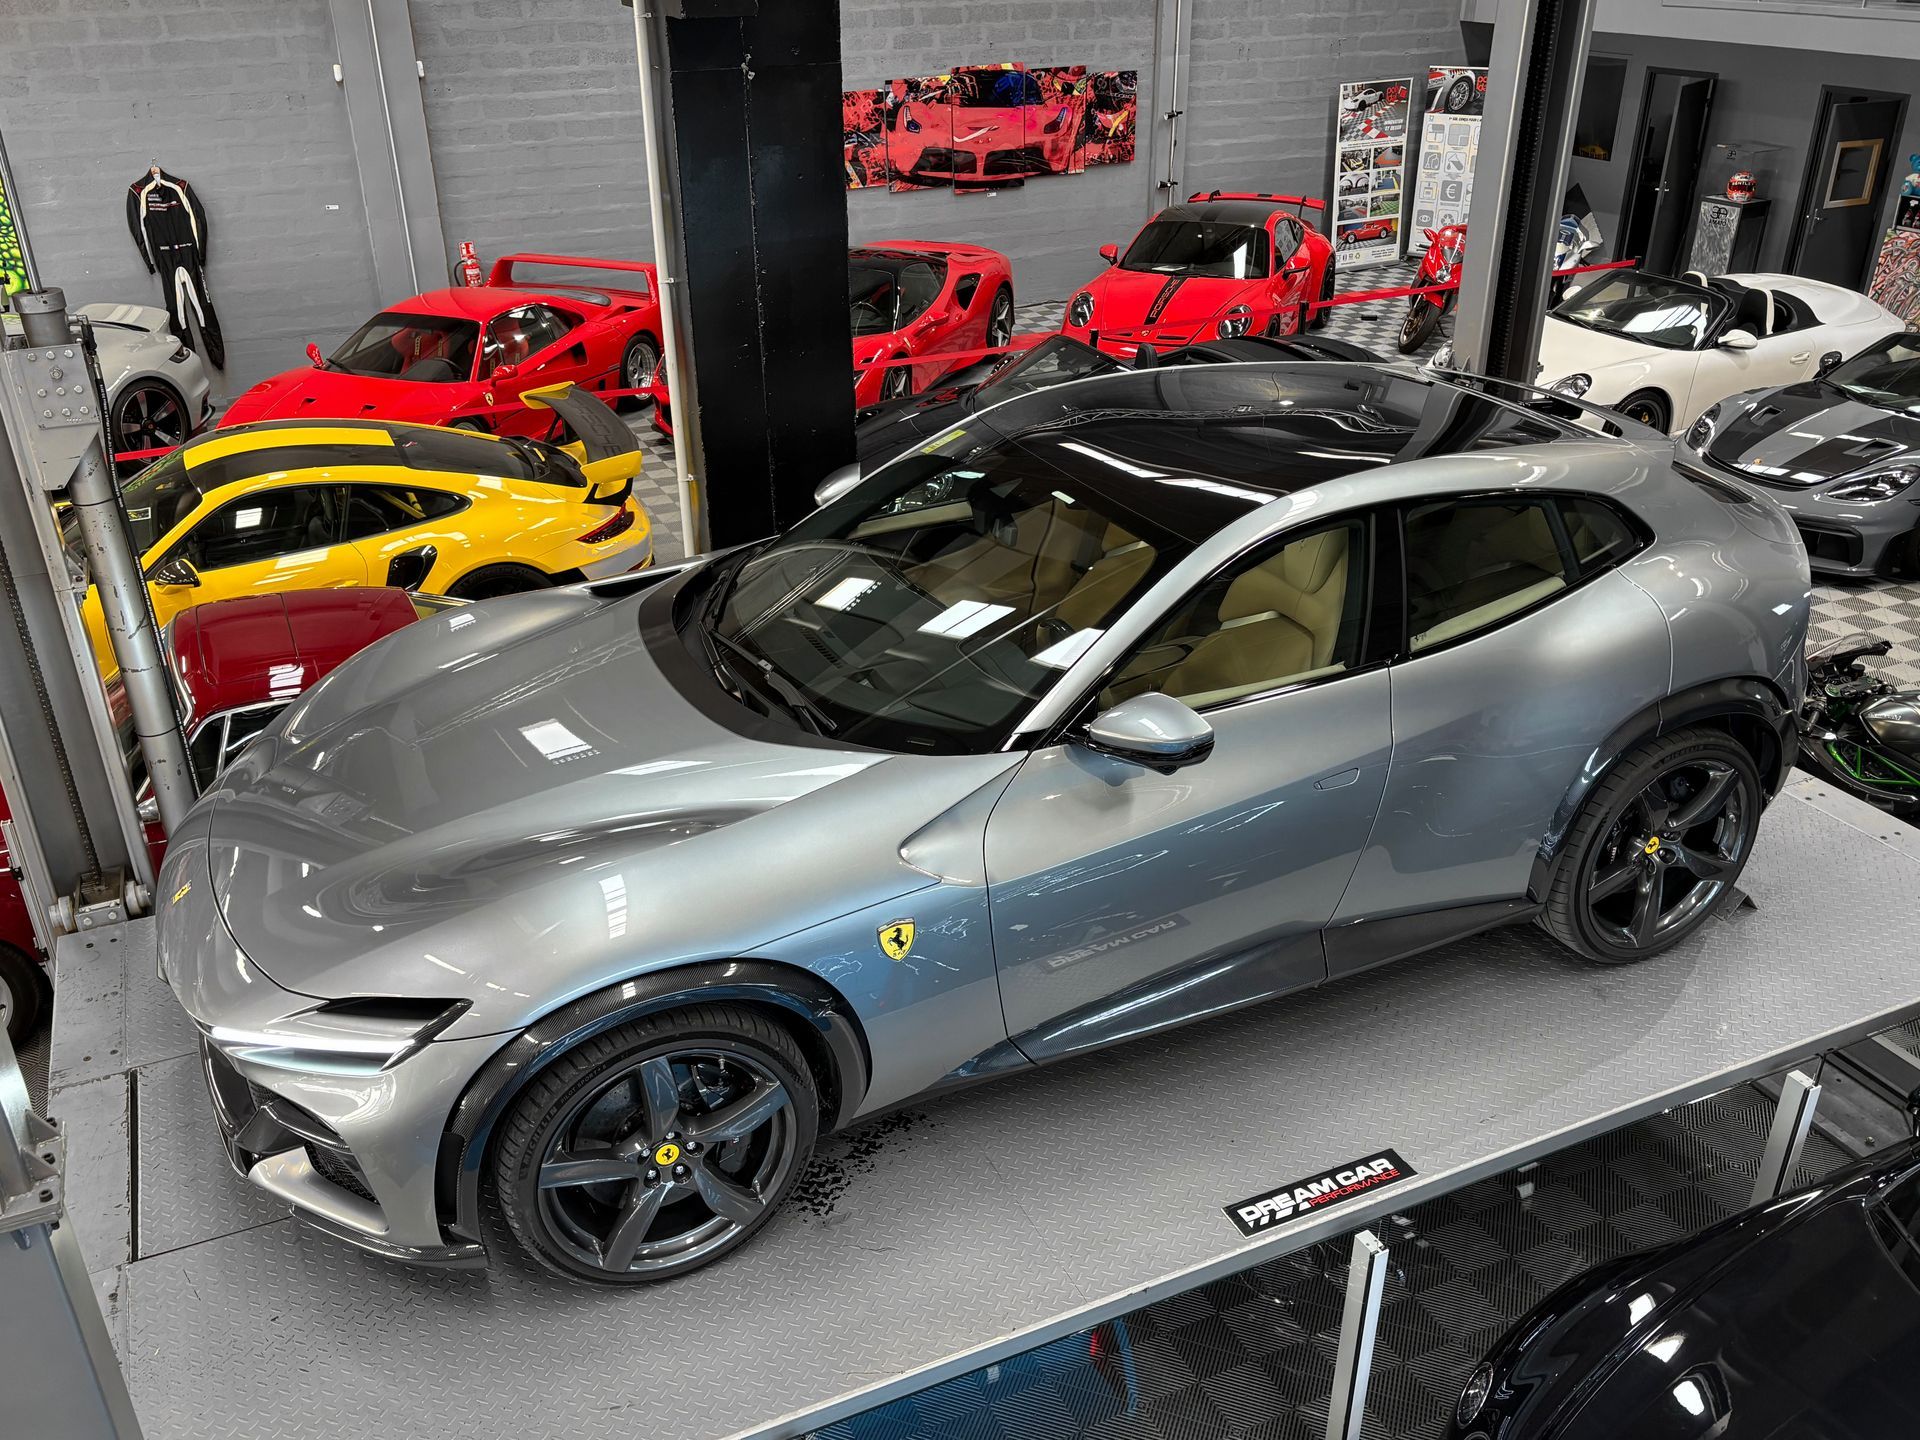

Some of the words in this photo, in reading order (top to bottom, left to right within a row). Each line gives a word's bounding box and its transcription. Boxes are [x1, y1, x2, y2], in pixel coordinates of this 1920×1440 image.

[1149, 279, 1180, 318] PORSCHE
[1237, 1177, 1338, 1223] DREAM
[1336, 1158, 1394, 1186] CAR
[1308, 1169, 1401, 1207] PERFORMANCE
